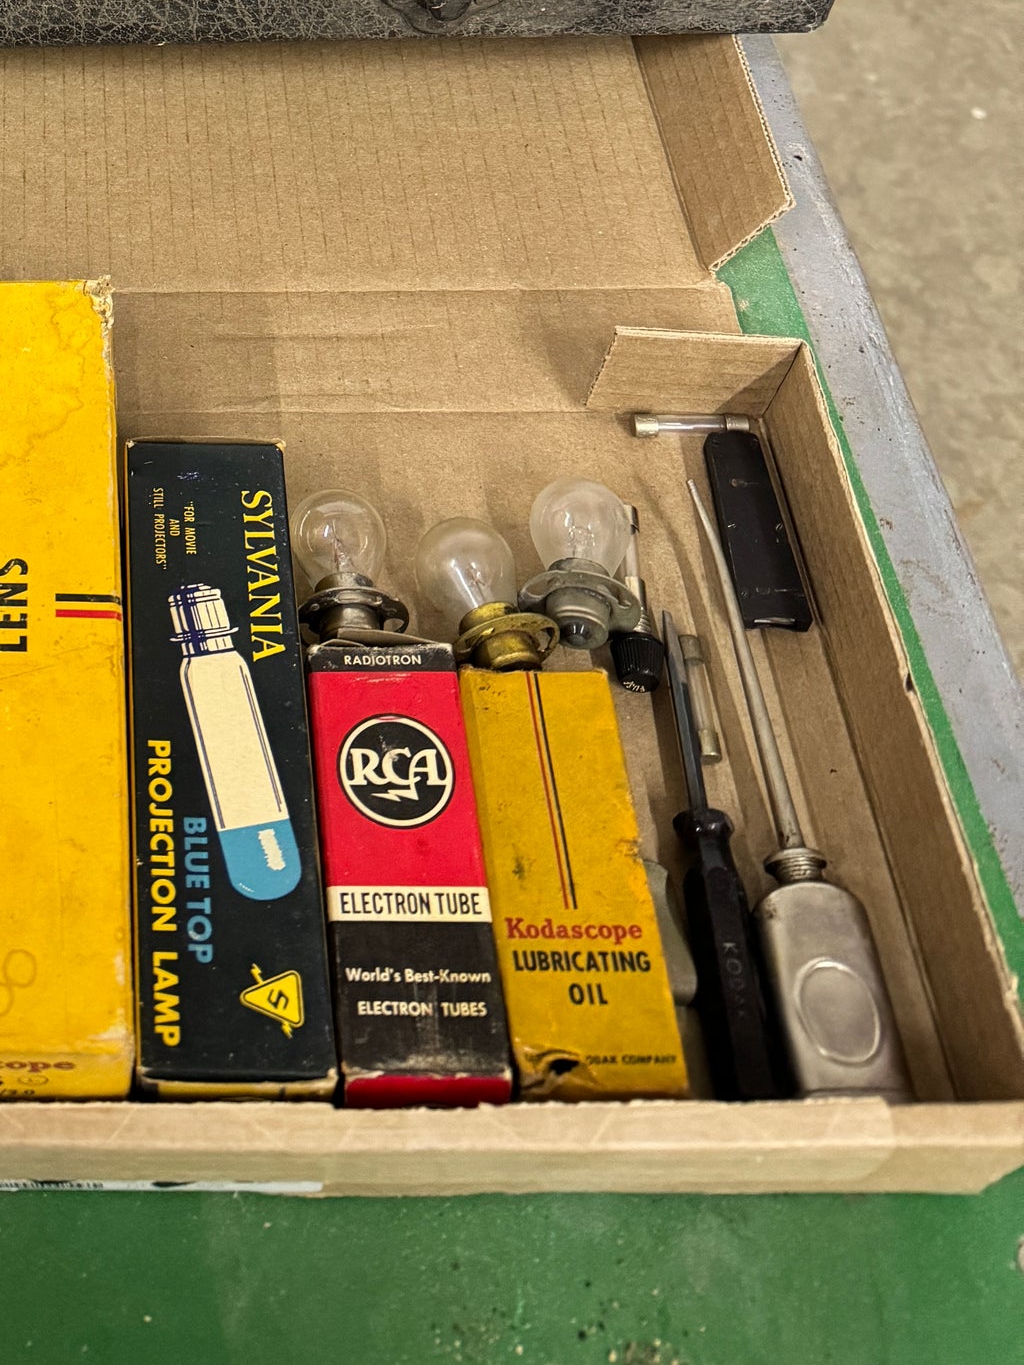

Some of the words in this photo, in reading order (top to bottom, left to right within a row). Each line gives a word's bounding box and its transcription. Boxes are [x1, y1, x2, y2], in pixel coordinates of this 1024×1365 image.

[152, 487, 164, 509] STILL
[169, 518, 180, 537] AND
[184, 527, 196, 555] MOVIE
[240, 490, 286, 662] SYLVANIA
[344, 654, 422, 666] RADIOTRON
[348, 747, 446, 787] RCA
[147, 739, 177, 931] PROJECTION
[183, 816, 210, 888] BLUE
[340, 892, 431, 915] ELECTRON
[436, 891, 483, 915] TUBE
[186, 897, 214, 964] TOP
[505, 918, 643, 945] Kodascope
[512, 951, 652, 972] LUBRICATING
[345, 968, 402, 982] World's
[404, 968, 491, 983] Best-Known
[152, 951, 181, 1047] LAMP
[568, 984, 608, 1005] OIL
[357, 1000, 433, 1015] ELECTRON
[441, 1001, 487, 1016] TUBES
[584, 1055, 617, 1064] ODAK
[621, 1054, 677, 1064] COMPANY
